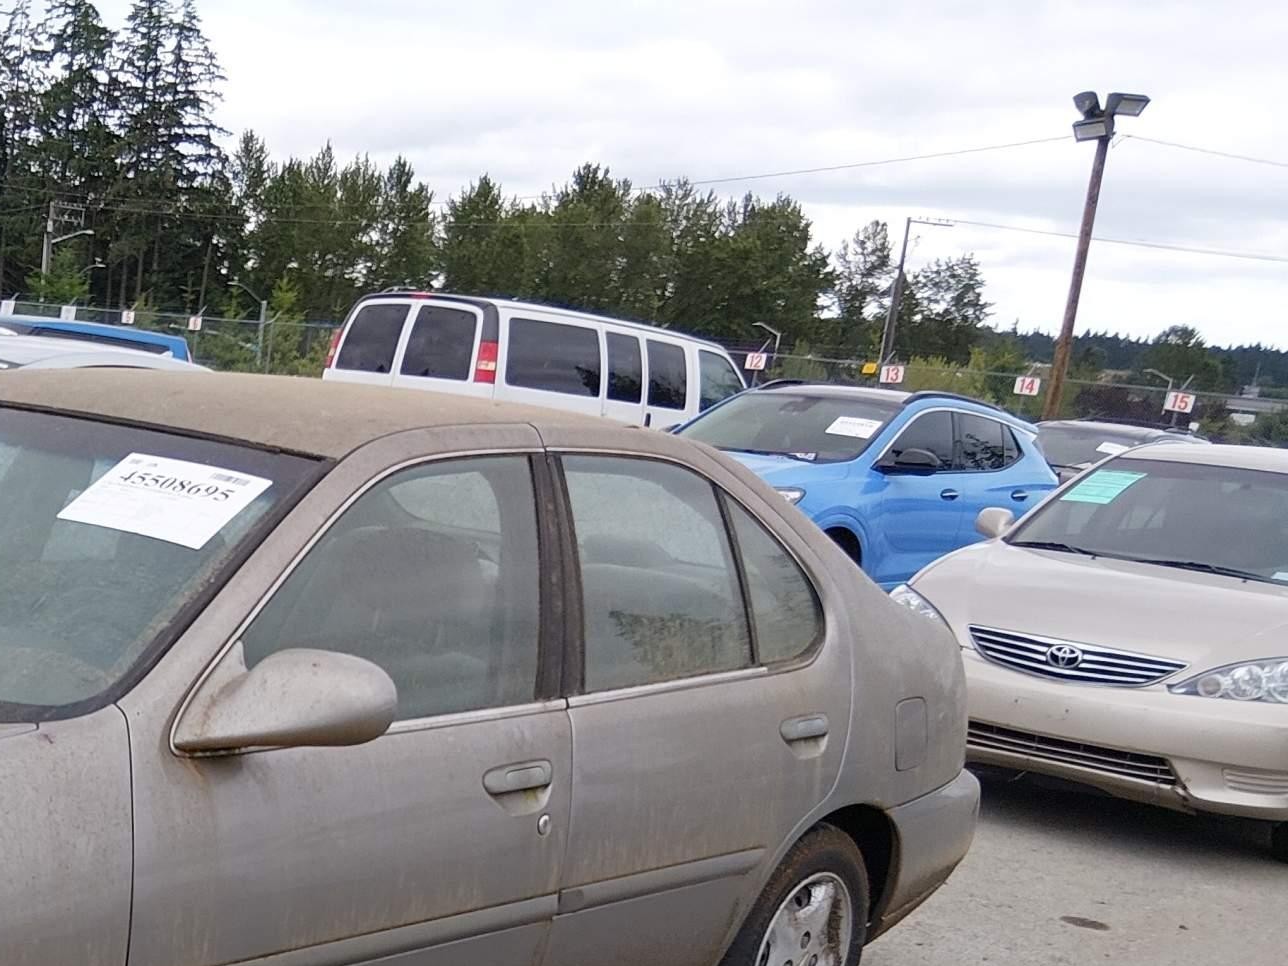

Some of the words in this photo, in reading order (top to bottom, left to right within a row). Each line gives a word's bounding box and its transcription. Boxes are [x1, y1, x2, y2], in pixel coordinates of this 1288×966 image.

[749, 354, 761, 368] 12
[886, 367, 899, 382] 13
[1020, 379, 1035, 393] 14
[1172, 394, 1190, 410] 15
[120, 471, 236, 501] 45508695
